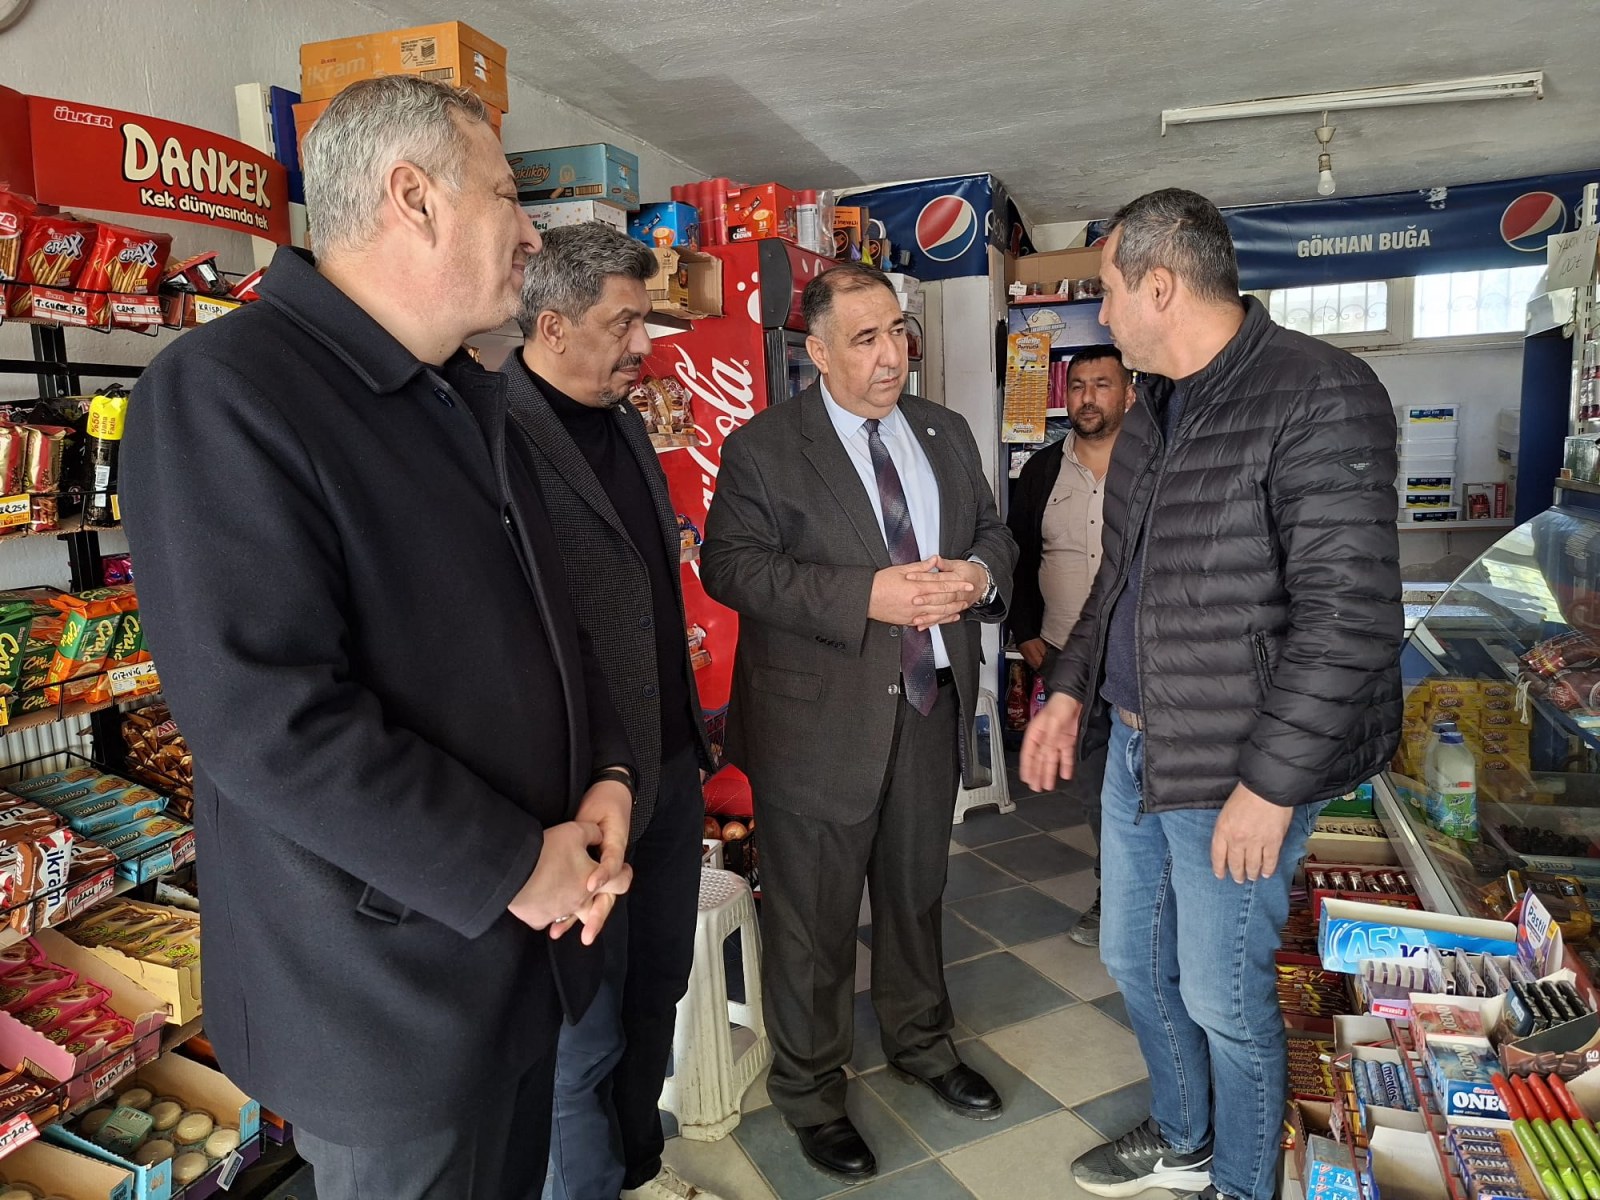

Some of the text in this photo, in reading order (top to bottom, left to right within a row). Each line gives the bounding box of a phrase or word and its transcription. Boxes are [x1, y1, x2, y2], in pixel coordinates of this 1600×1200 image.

[306, 57, 367, 85] ikram
[54, 106, 113, 128] ÜLKER
[121, 123, 271, 208] DANKEK
[140, 188, 269, 230] Kek dünyasında tek
[43, 231, 85, 260] CRAX
[732, 231, 752, 240] CROWN
[1297, 225, 1431, 258] GÖKHAN BUĞA
[119, 240, 158, 268] CRAX
[91, 412, 101, 433] %50
[46, 850, 65, 908] ikram
[1527, 905, 1547, 936] Pastil
[1586, 1051, 1600, 1059] 60
[1383, 1065, 1399, 1102] mentos
[1456, 1128, 1495, 1138] FALIM
[1462, 1143, 1501, 1153] FALIM
[1468, 1158, 1509, 1169] FALIM
[1474, 1173, 1517, 1184] FALIM
